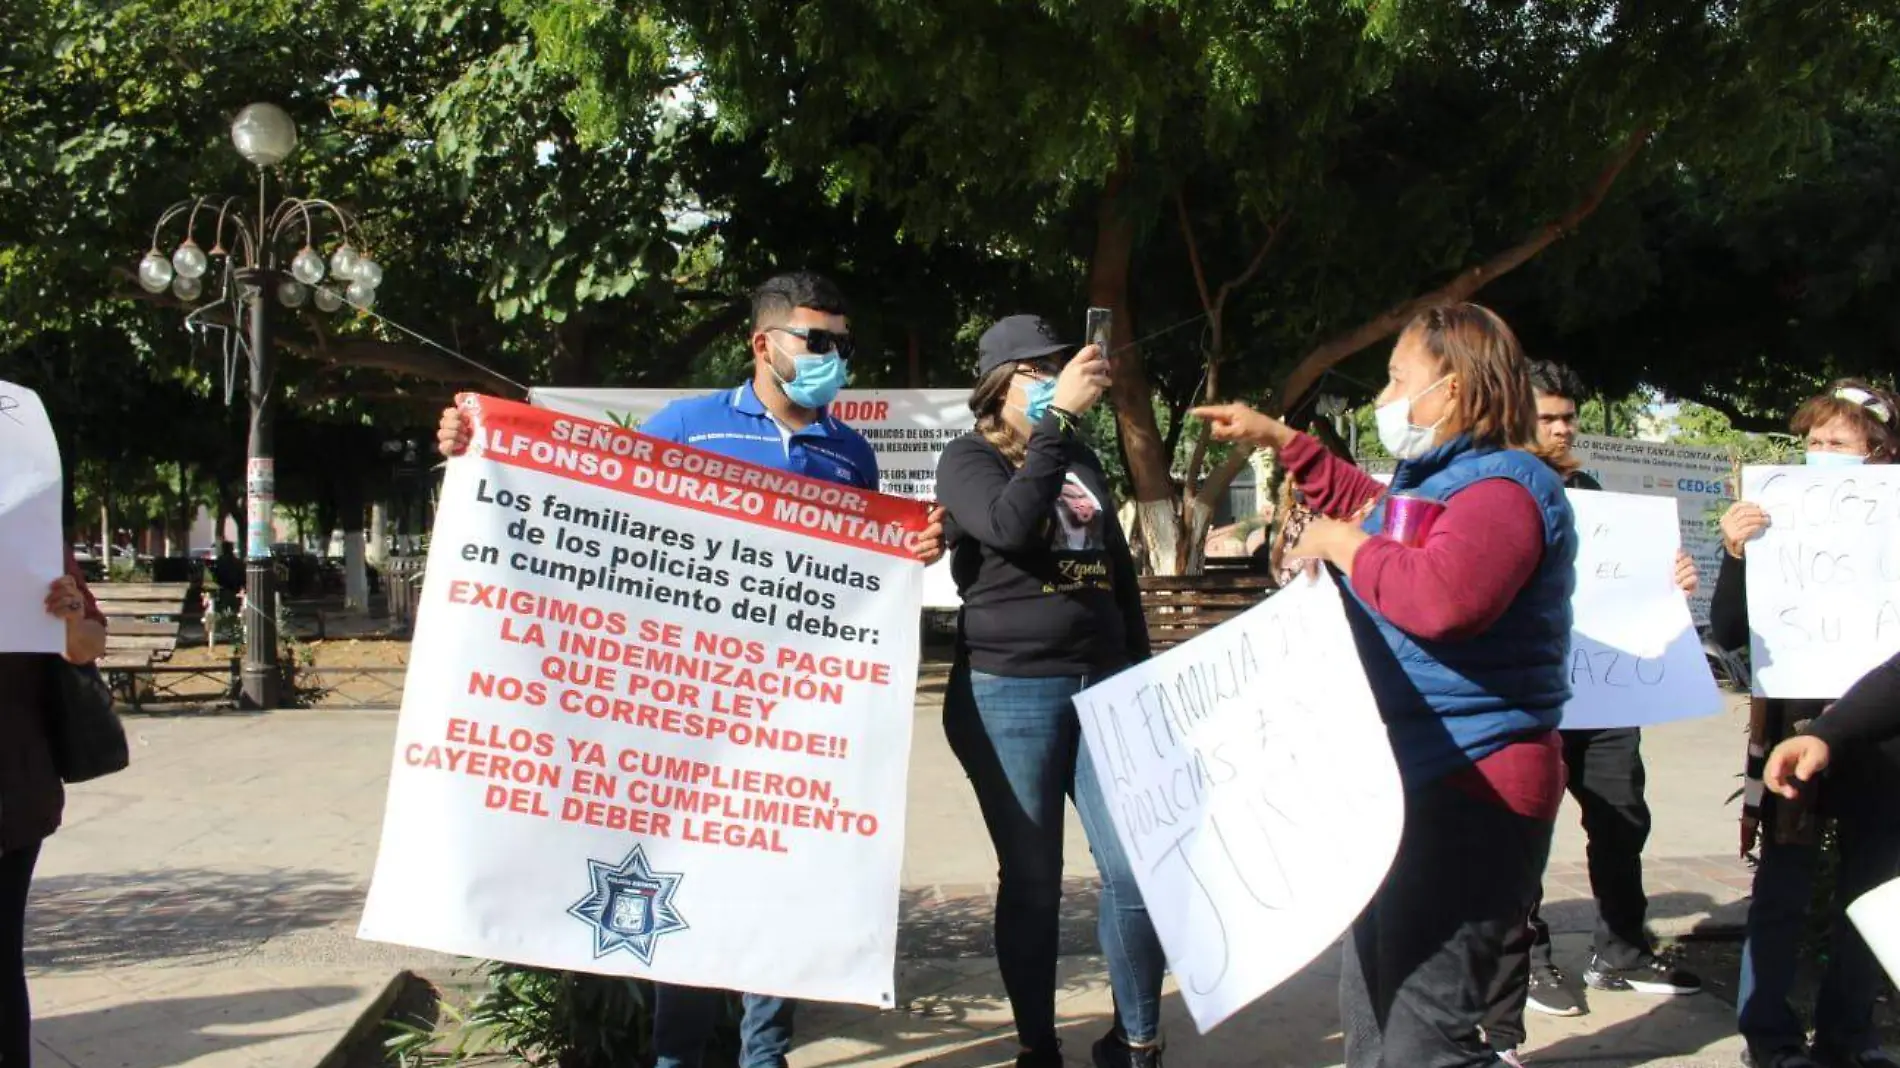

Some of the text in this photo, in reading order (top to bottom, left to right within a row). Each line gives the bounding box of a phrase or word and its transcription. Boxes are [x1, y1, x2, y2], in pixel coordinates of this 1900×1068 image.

[828, 401, 889, 421] ADOR
[919, 429, 934, 439] LOS
[1647, 447, 1675, 456] TANTA
[551, 419, 653, 461] SEÑOR
[662, 448, 867, 512] GOBERNADOR:
[633, 466, 764, 515] DURAZO
[476, 479, 881, 591] Los familiares y las Viudas
[507, 518, 836, 610] de los policias caídos
[449, 580, 890, 685] EXIGIMOS SE NOS PAGUE
[461, 543, 879, 644] en cumplimiento del deber:
[501, 618, 844, 704] LA INDEMNIZACIÓN
[541, 656, 779, 721] QUE POR LEY
[1135, 631, 1260, 759] FAMILIA
[468, 672, 848, 759] NOS CORRESPONDE!!
[404, 743, 878, 837] CAYERON EN CUMPLIMIENTO
[445, 718, 840, 808] ELLOS YA CUMPLIERON,
[485, 784, 788, 853] DEL DEBER LEGAL
